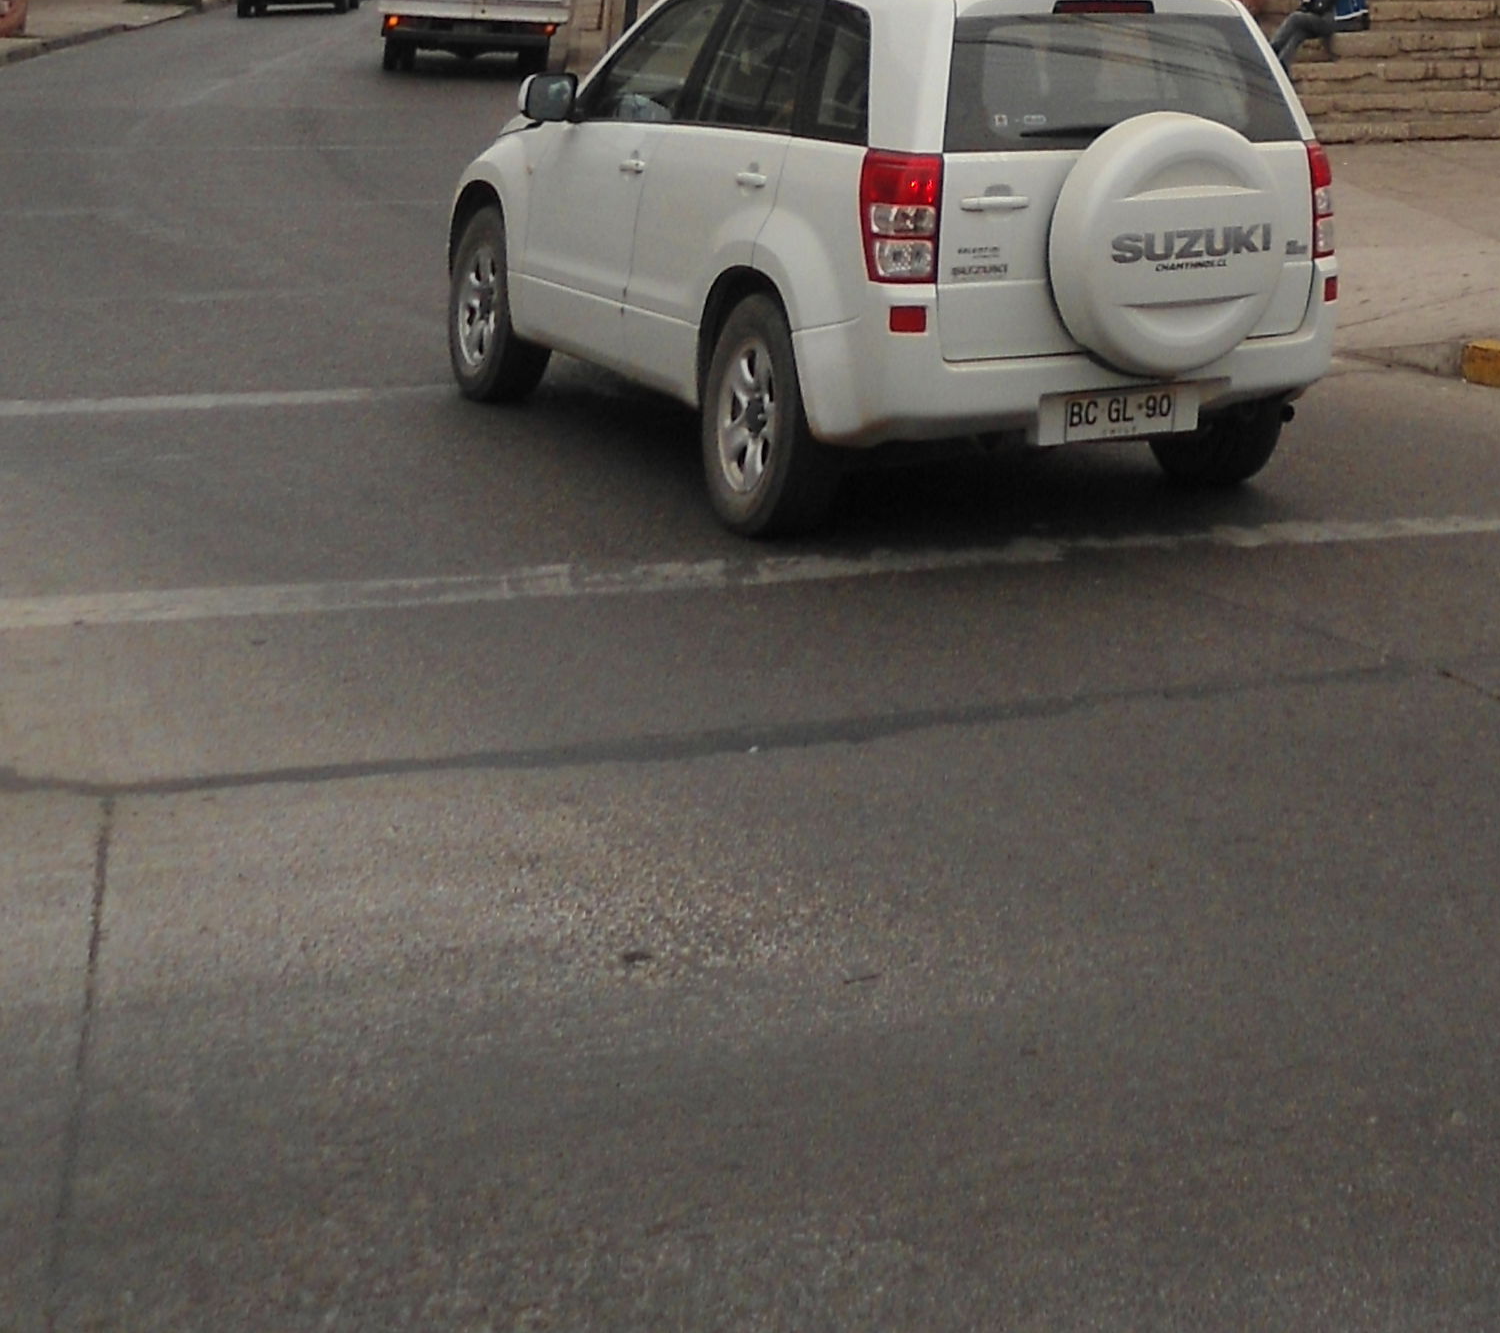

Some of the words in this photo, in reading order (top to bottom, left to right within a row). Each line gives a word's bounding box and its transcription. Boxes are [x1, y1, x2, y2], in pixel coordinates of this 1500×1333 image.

[1111, 223, 1272, 264] SUZUKI
[1069, 400, 1099, 428] BC
[1107, 396, 1134, 424] GL
